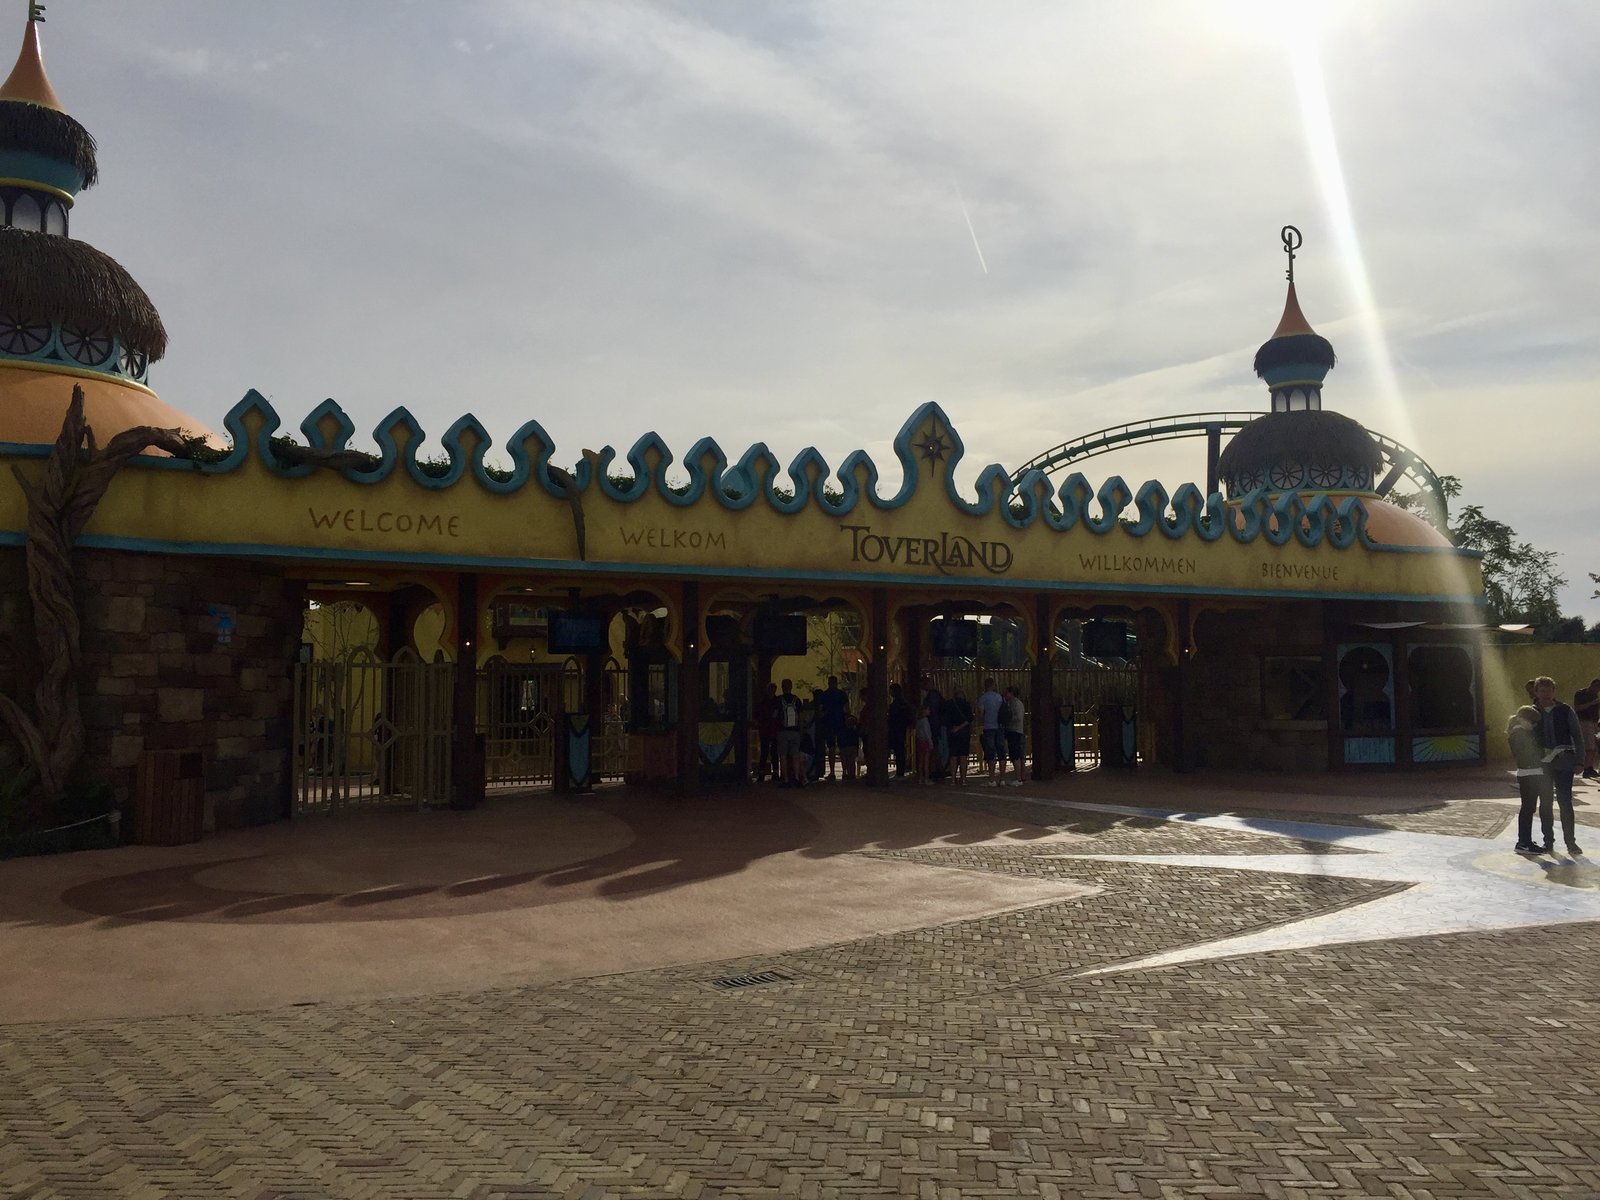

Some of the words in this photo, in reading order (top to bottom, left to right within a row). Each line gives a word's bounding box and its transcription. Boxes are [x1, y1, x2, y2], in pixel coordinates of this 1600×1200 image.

[308, 507, 460, 537] WELCOME
[621, 527, 726, 549] WELKOM
[840, 525, 1014, 574] TOVERLAND
[1079, 554, 1196, 575] WILLKOMMEN
[1262, 562, 1339, 582] BIENVENUE
